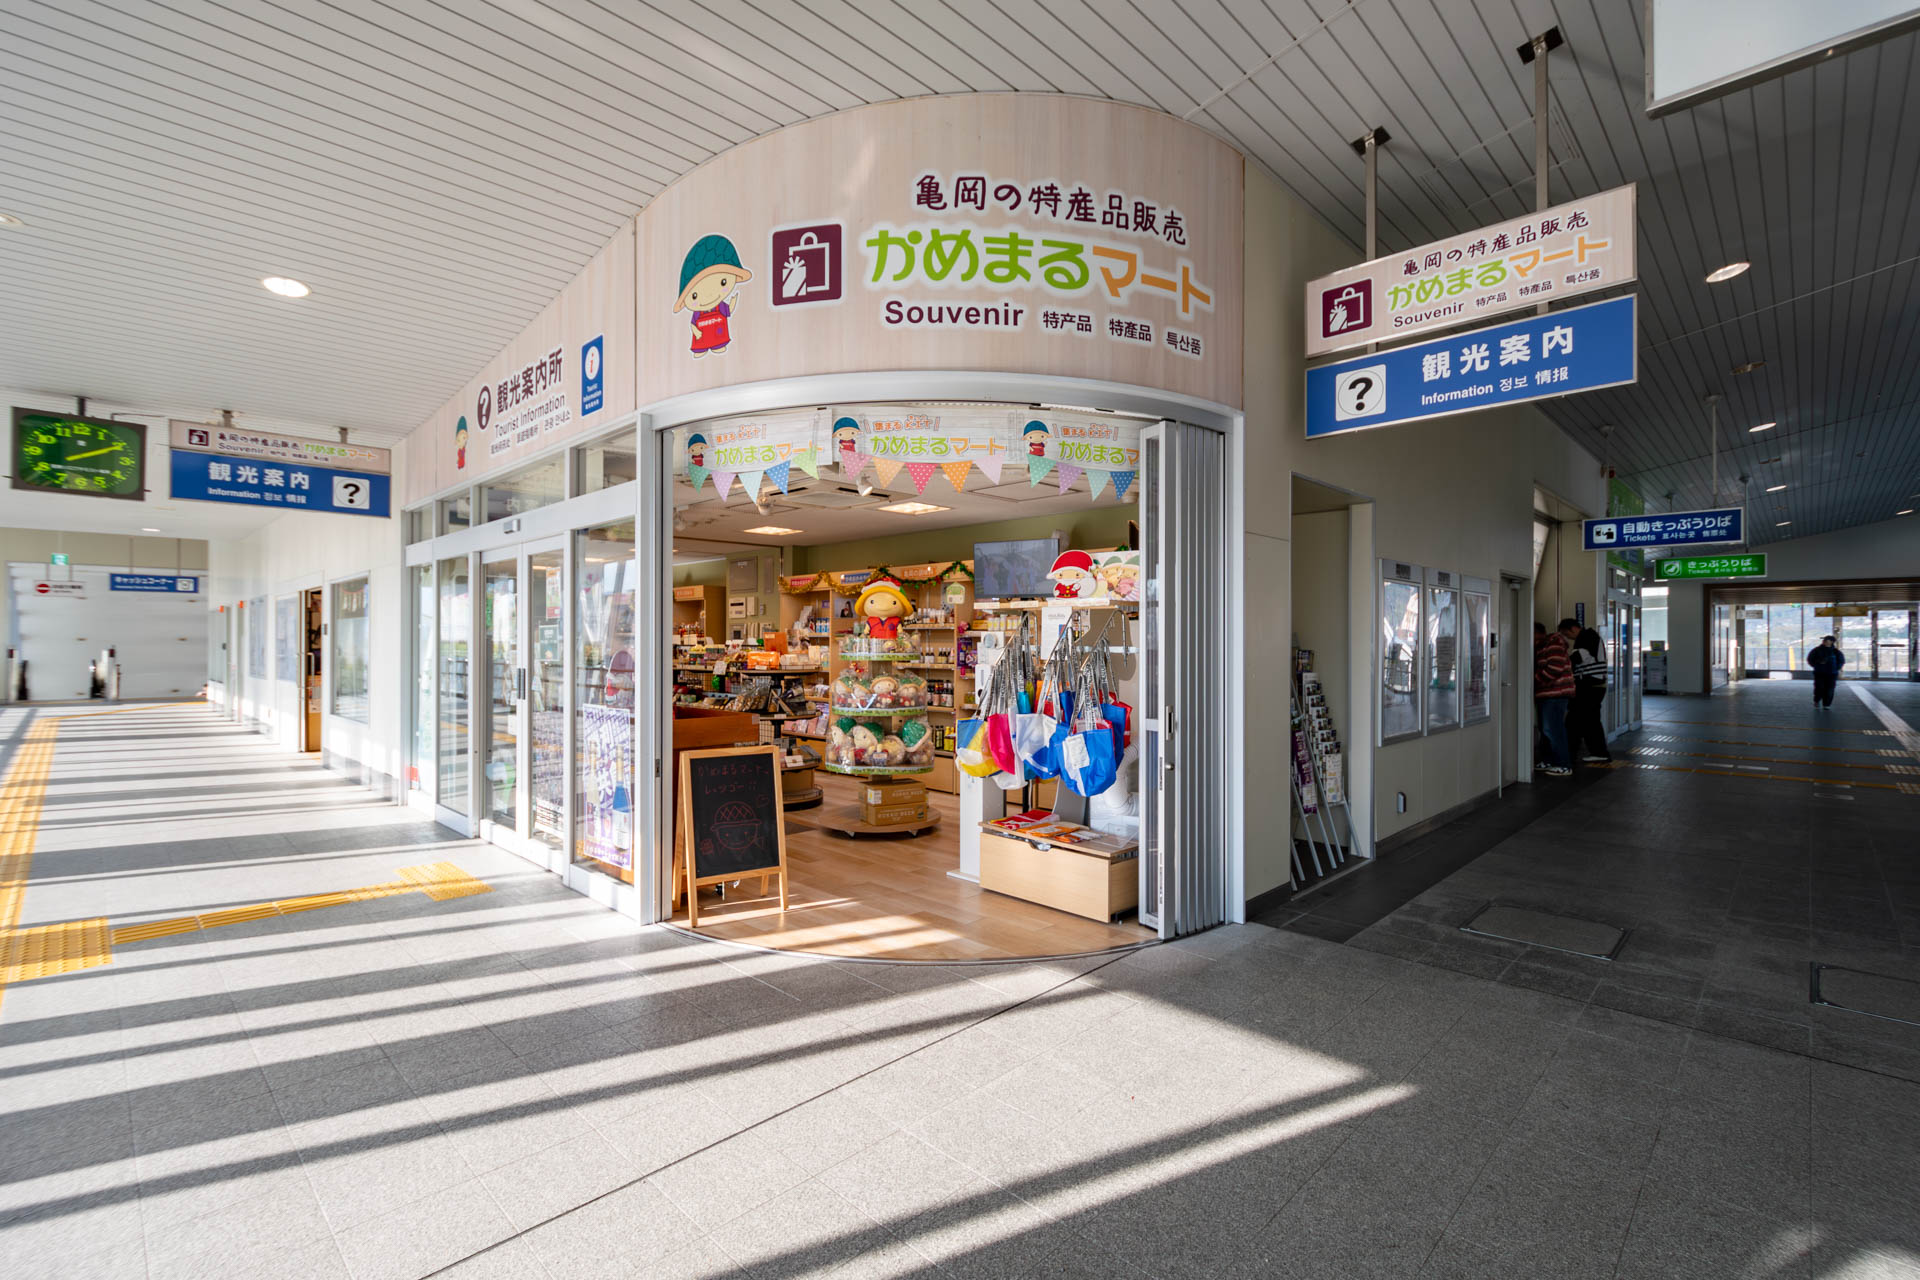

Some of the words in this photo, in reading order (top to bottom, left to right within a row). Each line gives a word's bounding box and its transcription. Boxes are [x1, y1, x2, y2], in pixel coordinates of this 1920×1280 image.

[915, 174, 1188, 246] 亀岡の特産品販売
[1403, 211, 1590, 277] 亀岡の特産品販売
[866, 227, 1211, 315] かめまるマート
[1386, 235, 1609, 312] かめまるマート
[1394, 302, 1465, 328] Souvenir
[1565, 267, 1600, 286] 특산품
[884, 299, 1024, 328] Souvenir
[1042, 310, 1092, 333] 特产品
[1108, 317, 1152, 343] 特產品
[1165, 330, 1201, 357] 특산품
[1422, 325, 1574, 384] 観光案内
[497, 348, 563, 415] 観光案内所
[1421, 382, 1493, 406] Information
[1499, 375, 1528, 393] 정보
[494, 416, 520, 439] Tourist
[520, 395, 566, 426] Information
[217, 442, 264, 454] Souvenir
[714, 438, 823, 466] かめまるマート
[870, 436, 1005, 456] かめまるマート
[208, 462, 310, 490] 観光案内
[208, 487, 261, 499] Information
[1622, 514, 1733, 535] 自動きっぷうりば
[1623, 533, 1656, 543] Tickets
[1687, 558, 1752, 569] きっぷうりば
